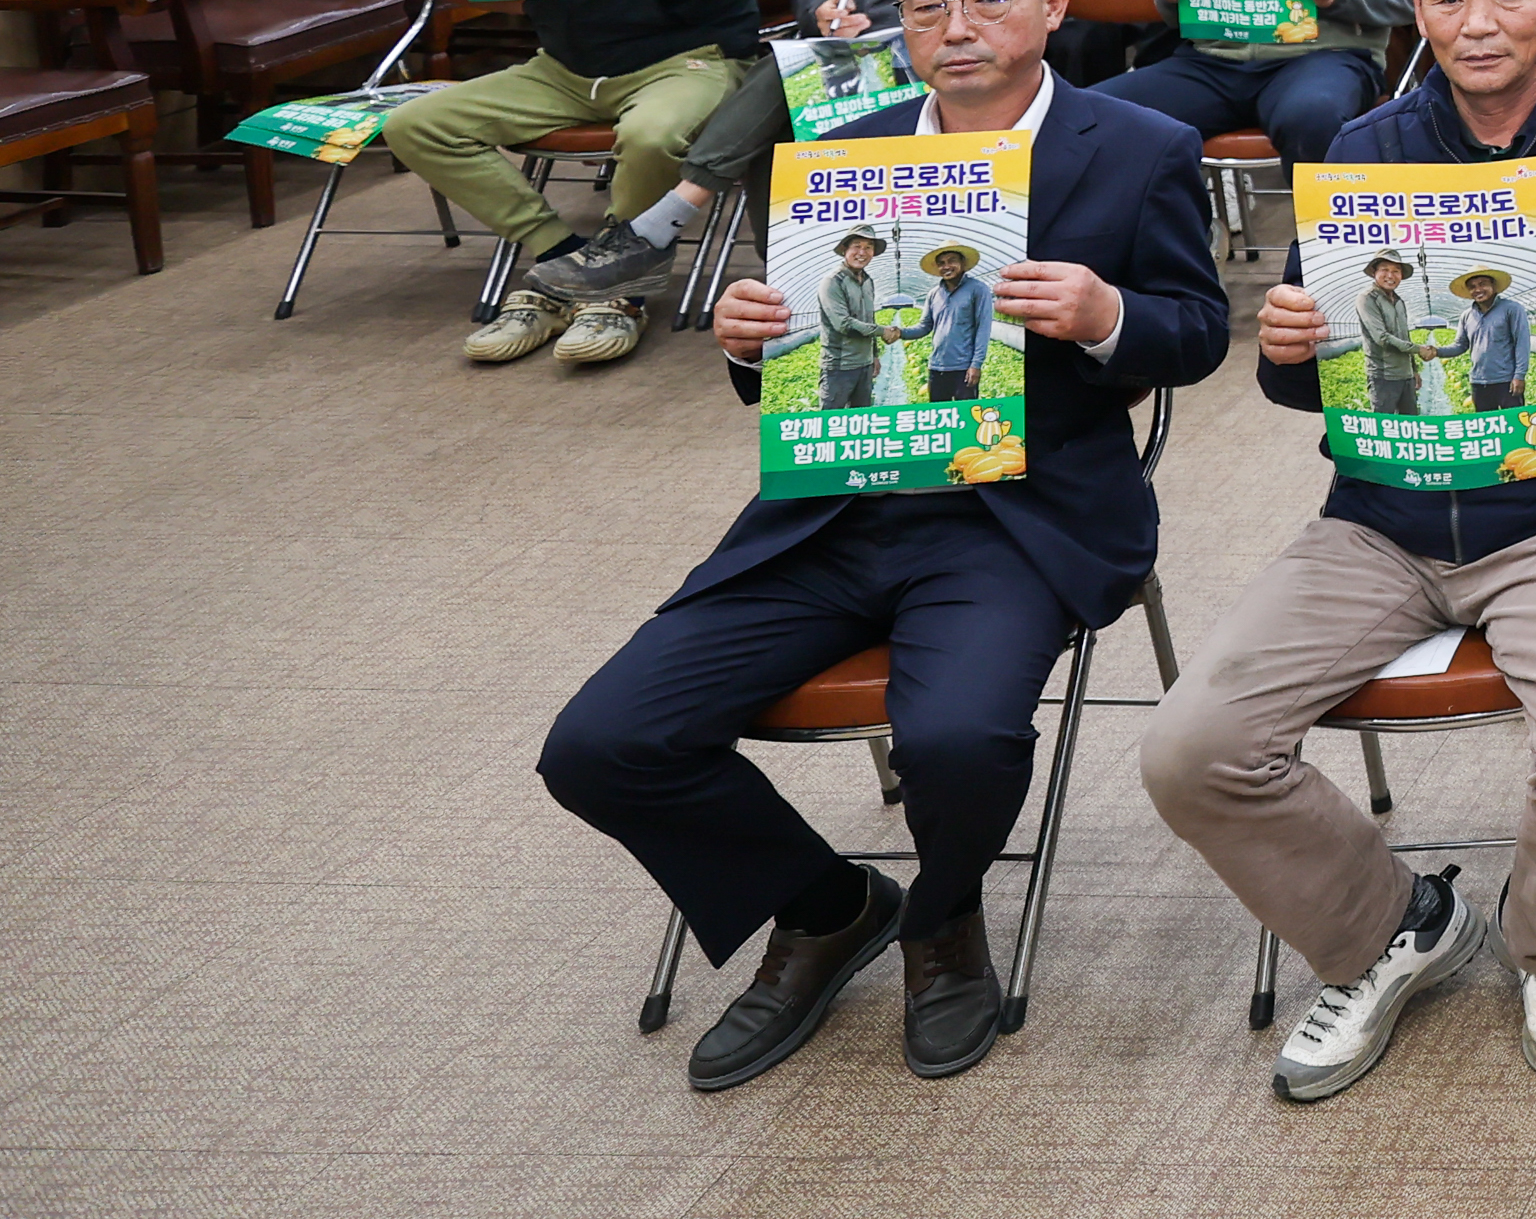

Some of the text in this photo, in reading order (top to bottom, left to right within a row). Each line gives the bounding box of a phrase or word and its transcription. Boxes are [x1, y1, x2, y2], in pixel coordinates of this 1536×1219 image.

[809, 162, 991, 195] 외국인 근로자도
[791, 189, 1008, 225] 우리의 가족입니다.
[1331, 190, 1515, 217] 외국인 근로자도
[1317, 217, 1535, 245] 우리의 가족입니다.
[780, 407, 966, 441] 함께 일하는 동반자,
[1341, 414, 1514, 440] 함께 일하는 동반자,
[794, 433, 951, 465] 함께 지키는 권리
[1355, 437, 1502, 462] 함께 지키는 권리
